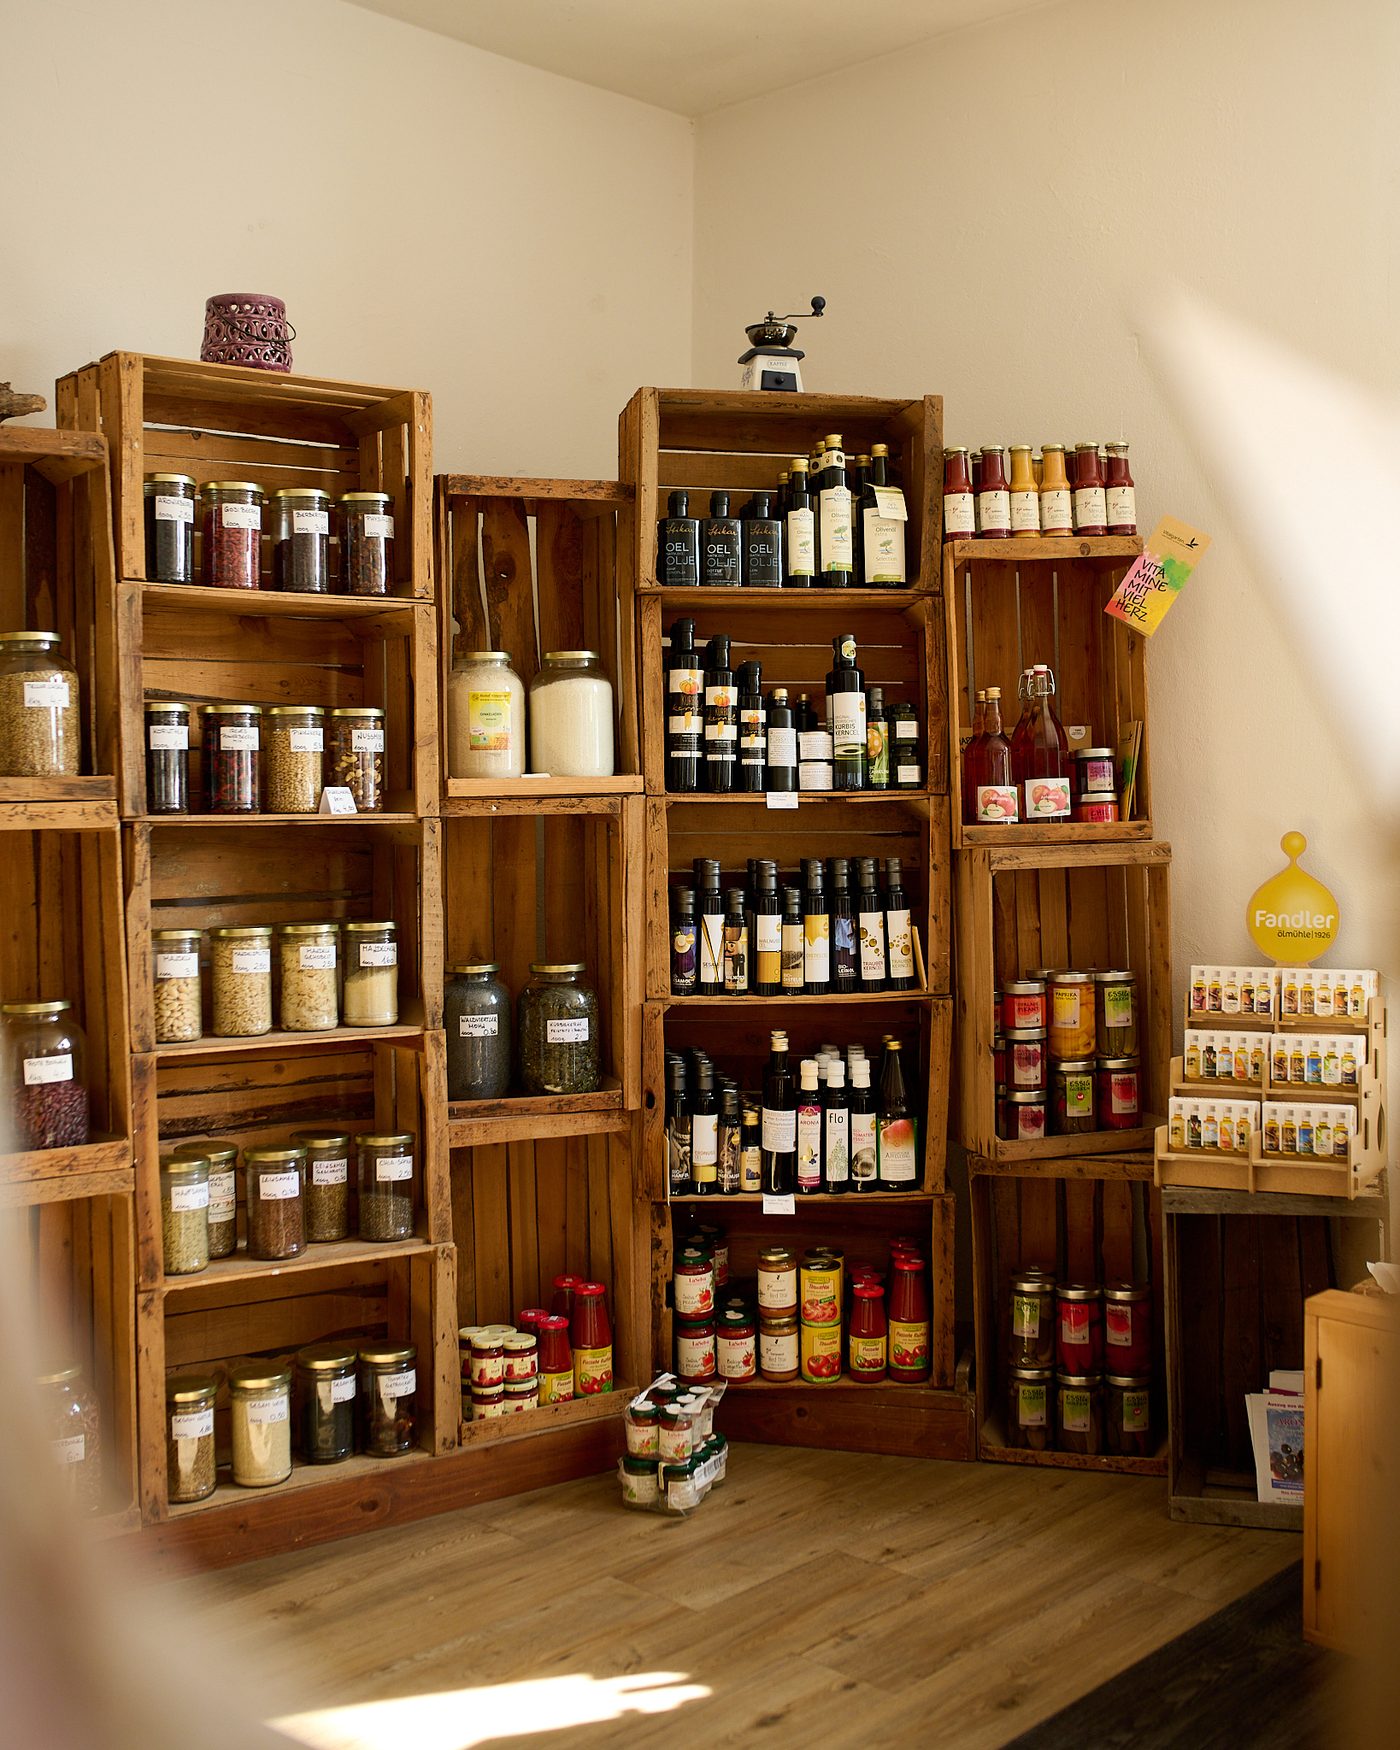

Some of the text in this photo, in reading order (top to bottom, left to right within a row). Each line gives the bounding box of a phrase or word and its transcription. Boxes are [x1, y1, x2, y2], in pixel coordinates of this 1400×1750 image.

[665, 542, 690, 552] OEL
[707, 544, 731, 555] OEL
[749, 544, 773, 554] OEL
[665, 556, 695, 566] OLJE
[707, 558, 737, 568] OLJE
[749, 558, 779, 567] OLJE
[1142, 559, 1166, 579] VITA
[1134, 570, 1169, 592] MINE
[1127, 579, 1153, 597] MIT
[1123, 588, 1147, 609] VIEL
[1115, 599, 1149, 622] HERZ
[1255, 909, 1335, 929] Fandler
[829, 1113, 844, 1124] flo
